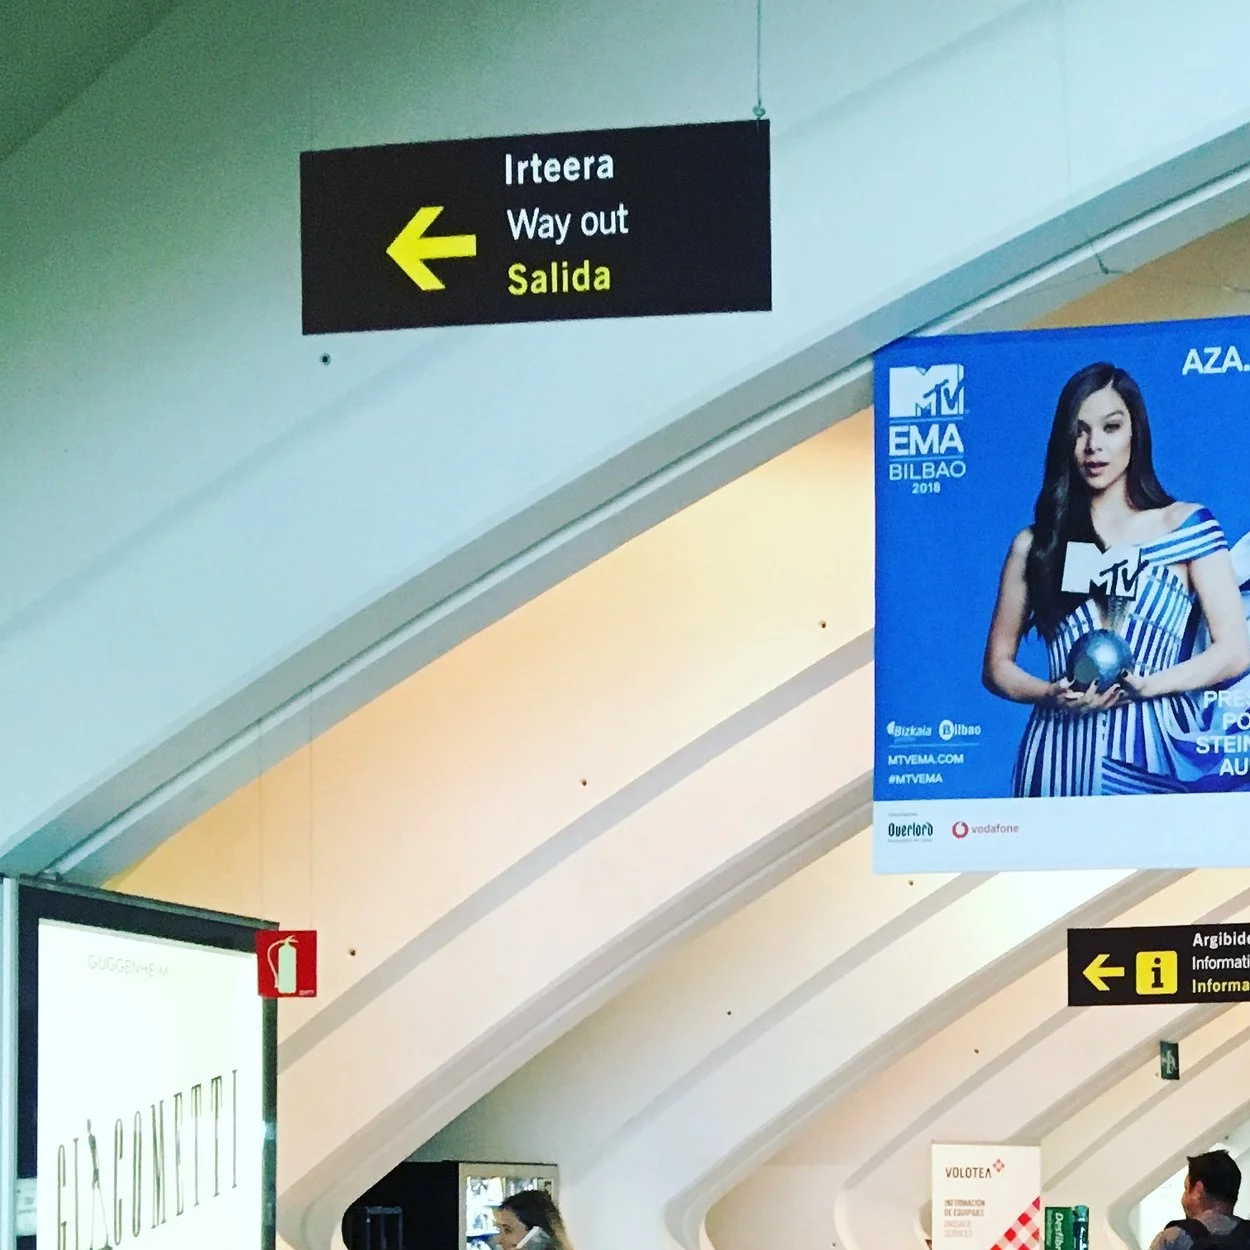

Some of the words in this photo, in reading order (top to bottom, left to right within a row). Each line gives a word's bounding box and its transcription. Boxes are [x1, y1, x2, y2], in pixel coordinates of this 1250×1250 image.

[504, 152, 615, 185] Irteera
[506, 207, 571, 246] Way
[580, 202, 630, 237] out
[507, 259, 612, 297] Salida
[1181, 345, 1250, 376] AZA.
[889, 363, 965, 418] MTV
[888, 422, 965, 457] EMA
[889, 460, 967, 481] BILBAO
[911, 481, 942, 495] 2018
[1061, 540, 1150, 601] MTV
[887, 753, 965, 766] MTVEMA.COM
[888, 773, 943, 785] #MTVEMA
[971, 823, 1020, 834] vodafone
[945, 1166, 992, 1179] VOLOTEA
